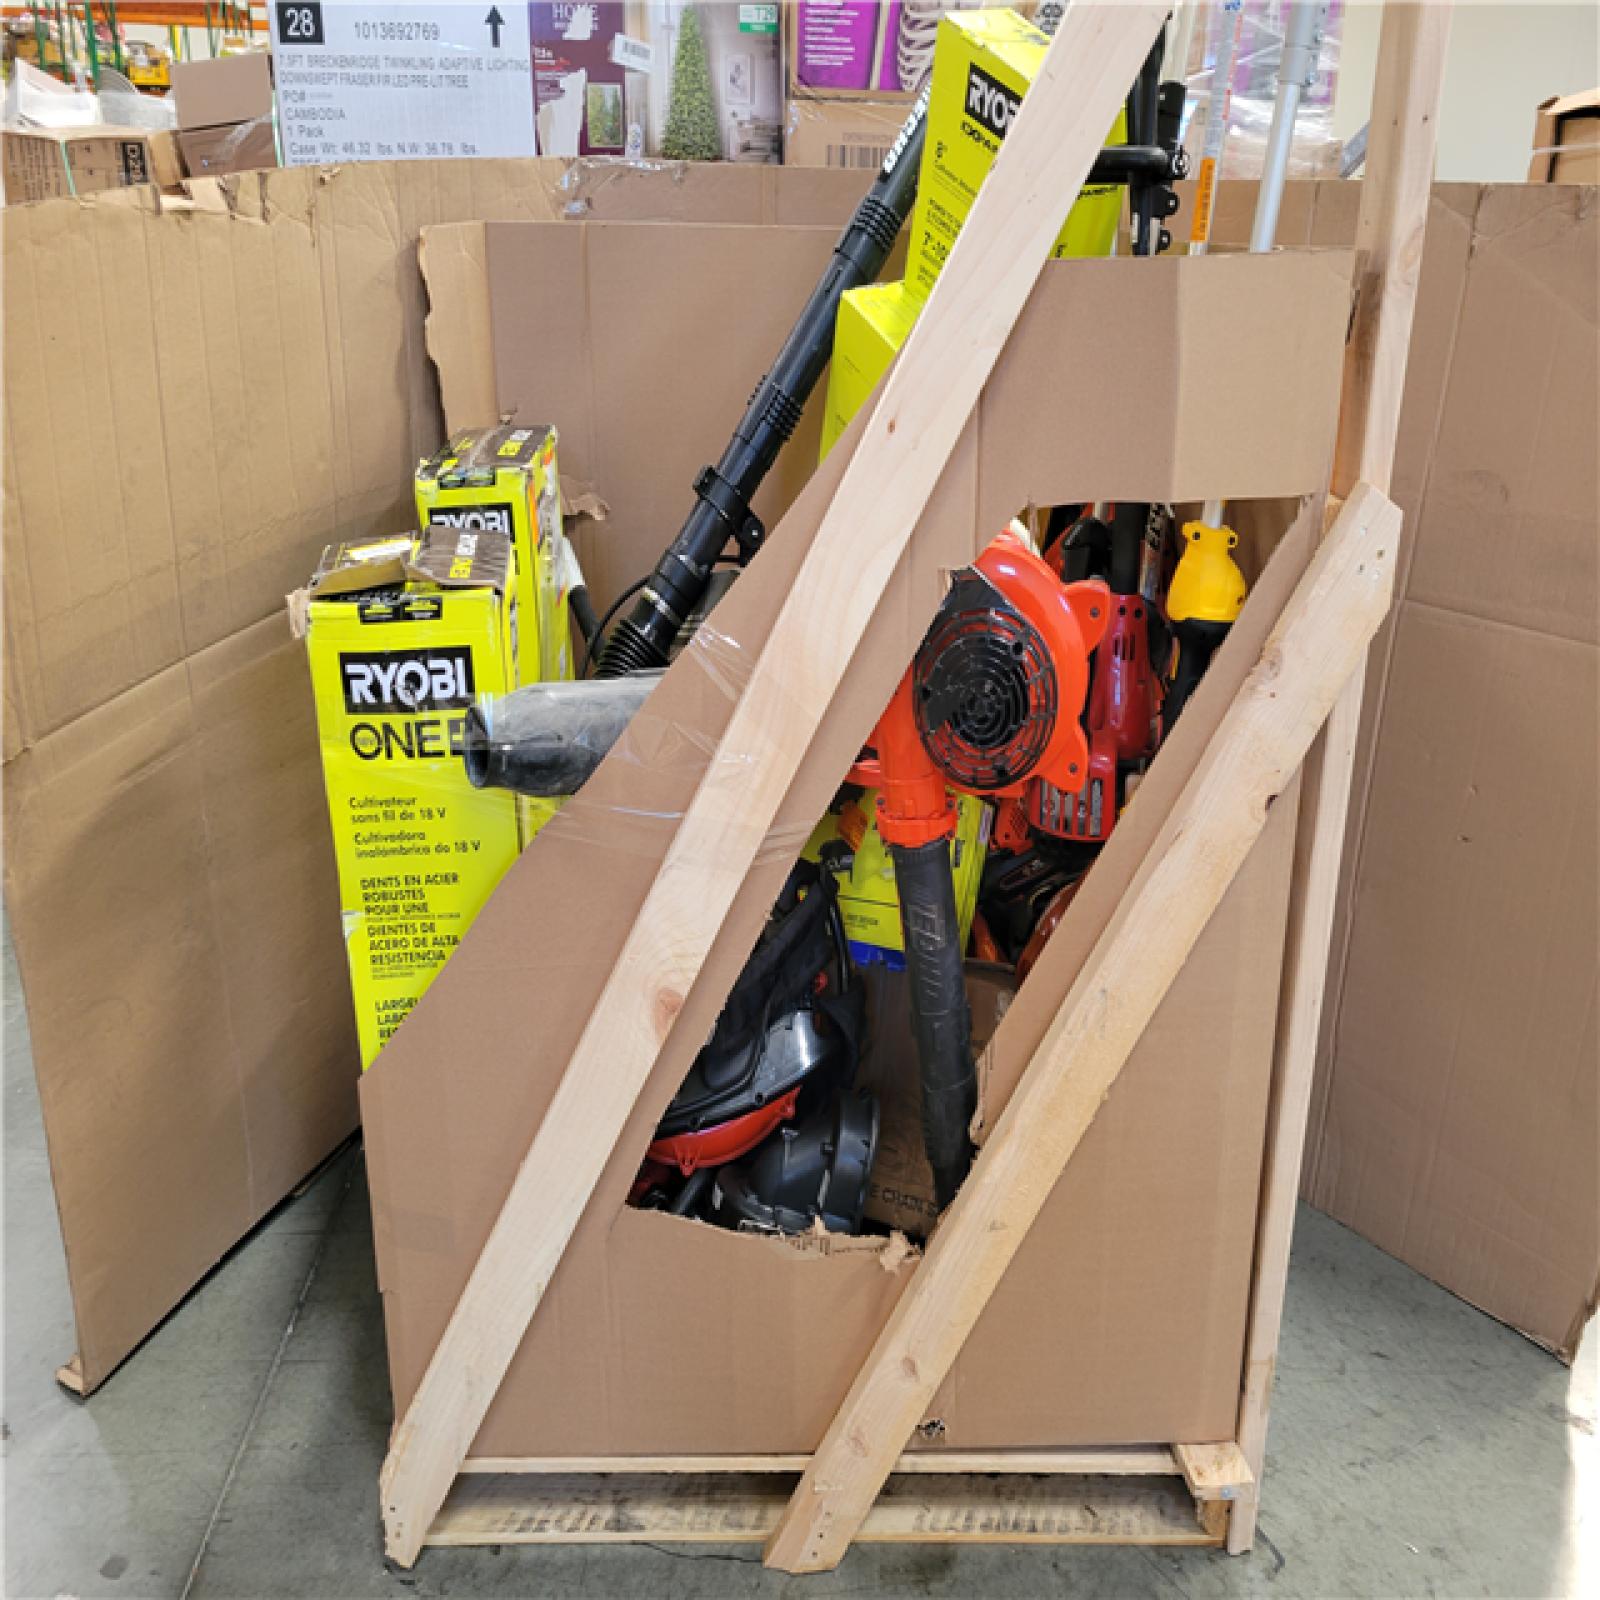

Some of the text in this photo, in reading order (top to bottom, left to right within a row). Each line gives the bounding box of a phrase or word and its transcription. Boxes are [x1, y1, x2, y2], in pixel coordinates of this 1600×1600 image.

[285, 7, 315, 37] 28
[285, 107, 346, 121] CAMBODIA
[297, 124, 326, 138] Pack
[289, 142, 316, 156] Case
[344, 656, 468, 707] RYOBI
[349, 796, 417, 810] Cultivateur
[351, 813, 380, 824] sans
[399, 809, 415, 821] de
[420, 807, 433, 820] 18
[437, 807, 447, 818] V
[354, 830, 426, 846] Cultivadora
[454, 841, 468, 853] 18
[470, 839, 481, 851] V
[360, 872, 459, 890] DENTS EN ACIER
[362, 887, 426, 902] ROBUSTES
[365, 901, 428, 916] POUR UNE
[367, 921, 436, 938] DIENTES DE
[369, 934, 460, 951] ACERO DE ALTA
[370, 949, 446, 965] RESISTENCIA
